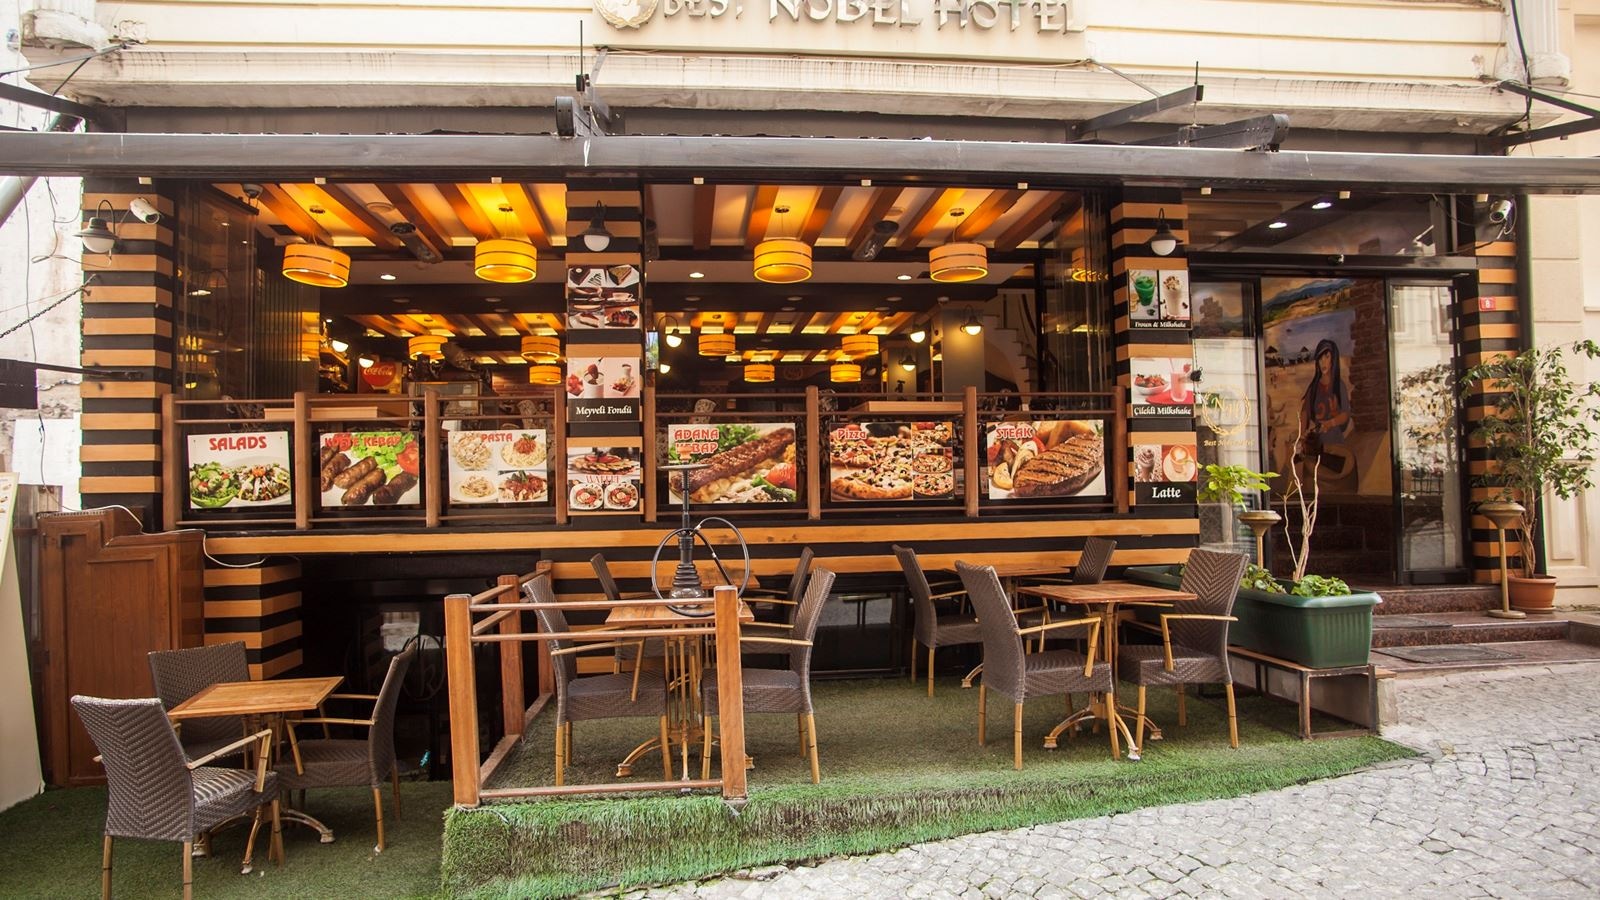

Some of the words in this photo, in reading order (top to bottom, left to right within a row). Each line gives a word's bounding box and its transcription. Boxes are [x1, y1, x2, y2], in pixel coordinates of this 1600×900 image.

[769, 0, 923, 27] NOBEL
[934, 0, 1089, 34] HOTEL
[1157, 406, 1192, 415] Milkshake
[480, 433, 513, 443] PASTA
[674, 429, 719, 440] ADANA
[837, 429, 867, 439] Pizza
[995, 427, 1033, 438] STEAK
[208, 435, 267, 452] SALADS
[675, 442, 719, 454] BAP
[1152, 486, 1181, 499] Latte
